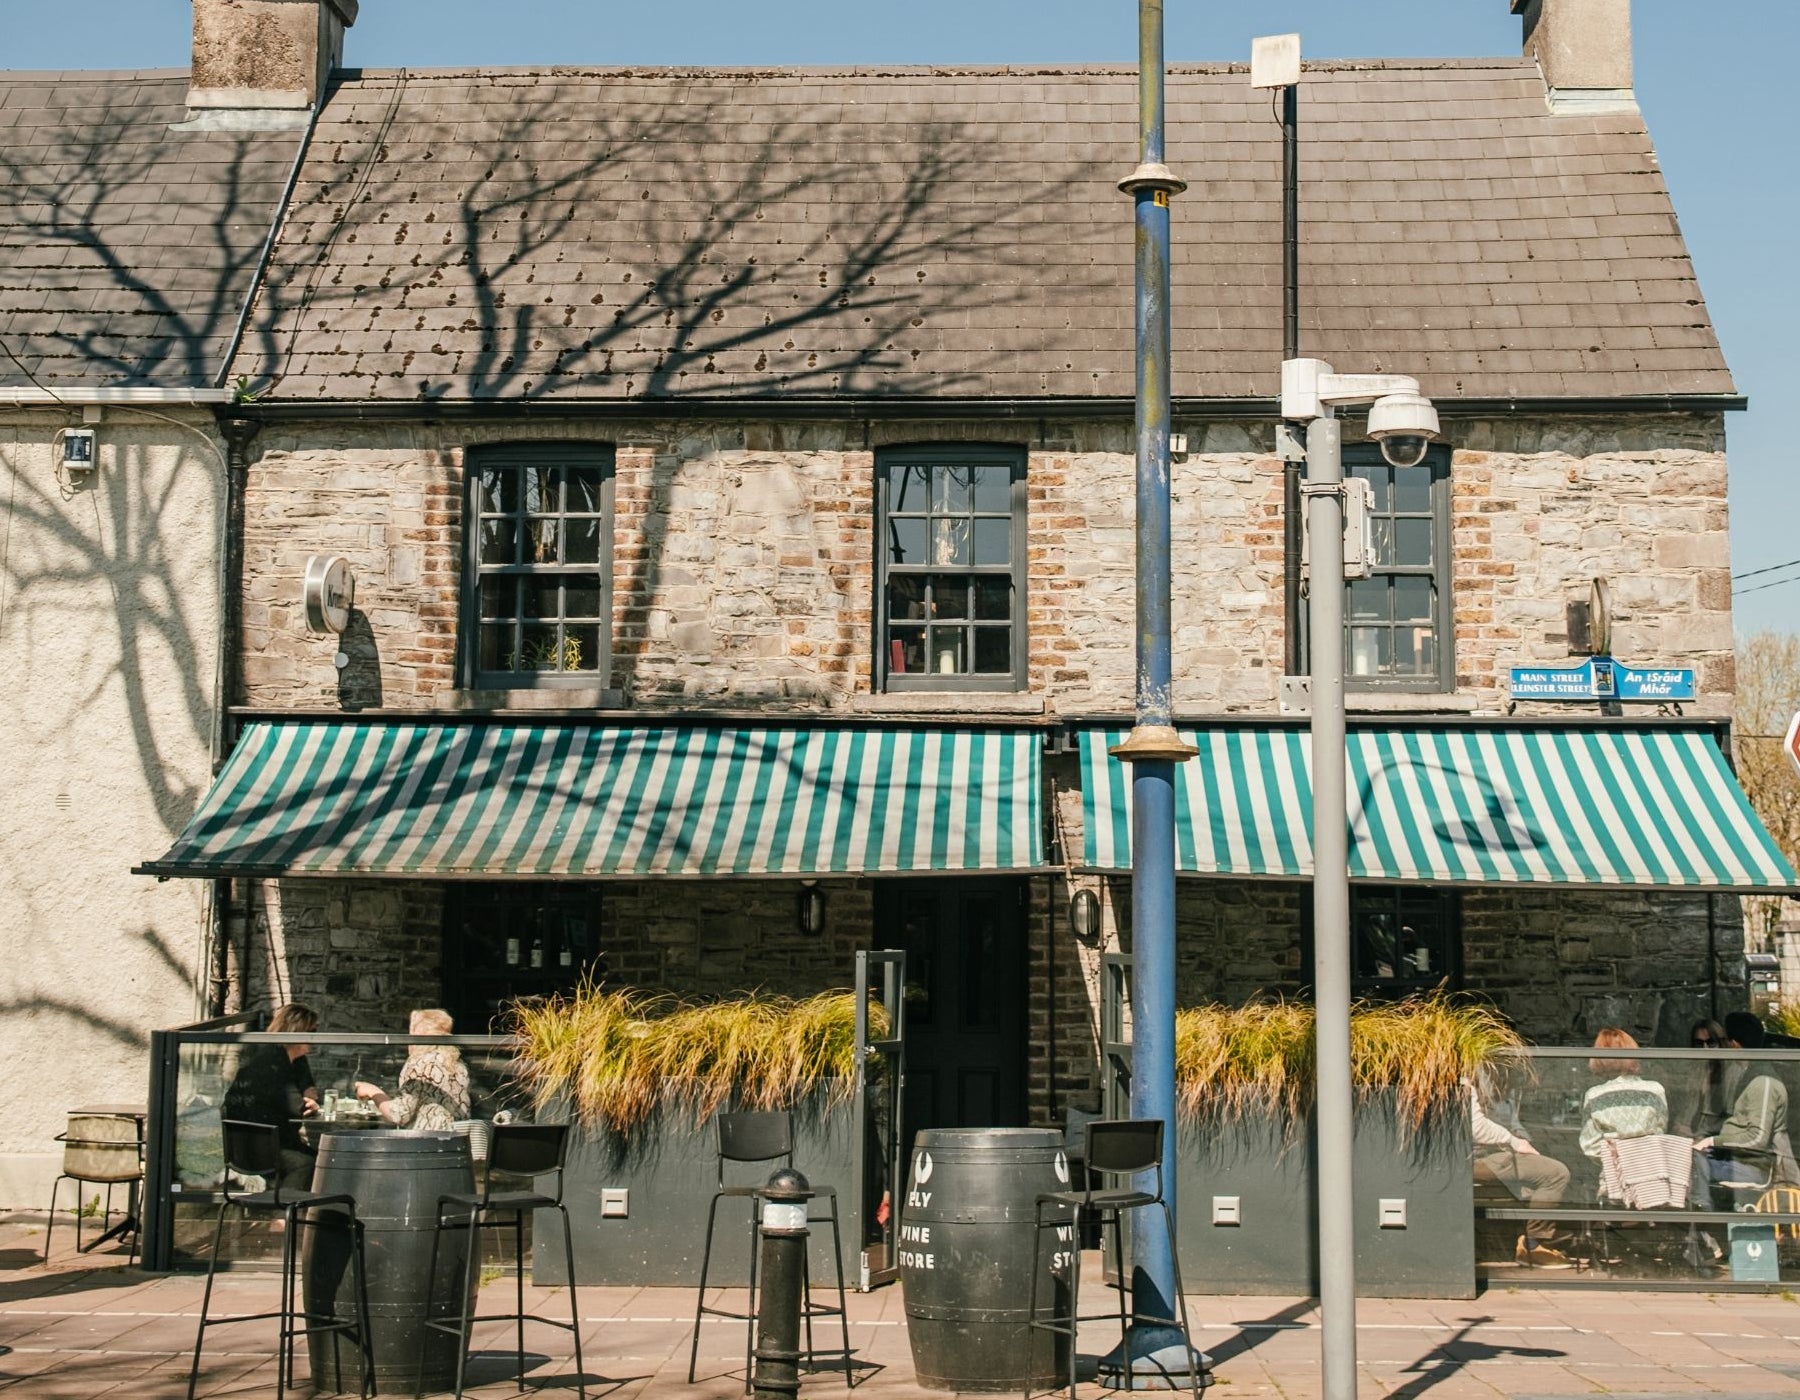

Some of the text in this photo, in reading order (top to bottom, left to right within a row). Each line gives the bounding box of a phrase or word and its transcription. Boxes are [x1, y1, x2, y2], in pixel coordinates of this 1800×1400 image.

[1520, 673, 1584, 682] MAIN STREET
[1624, 671, 1642, 682] An
[1639, 683, 1672, 694] Mhór
[908, 1191, 932, 1208] ELY
